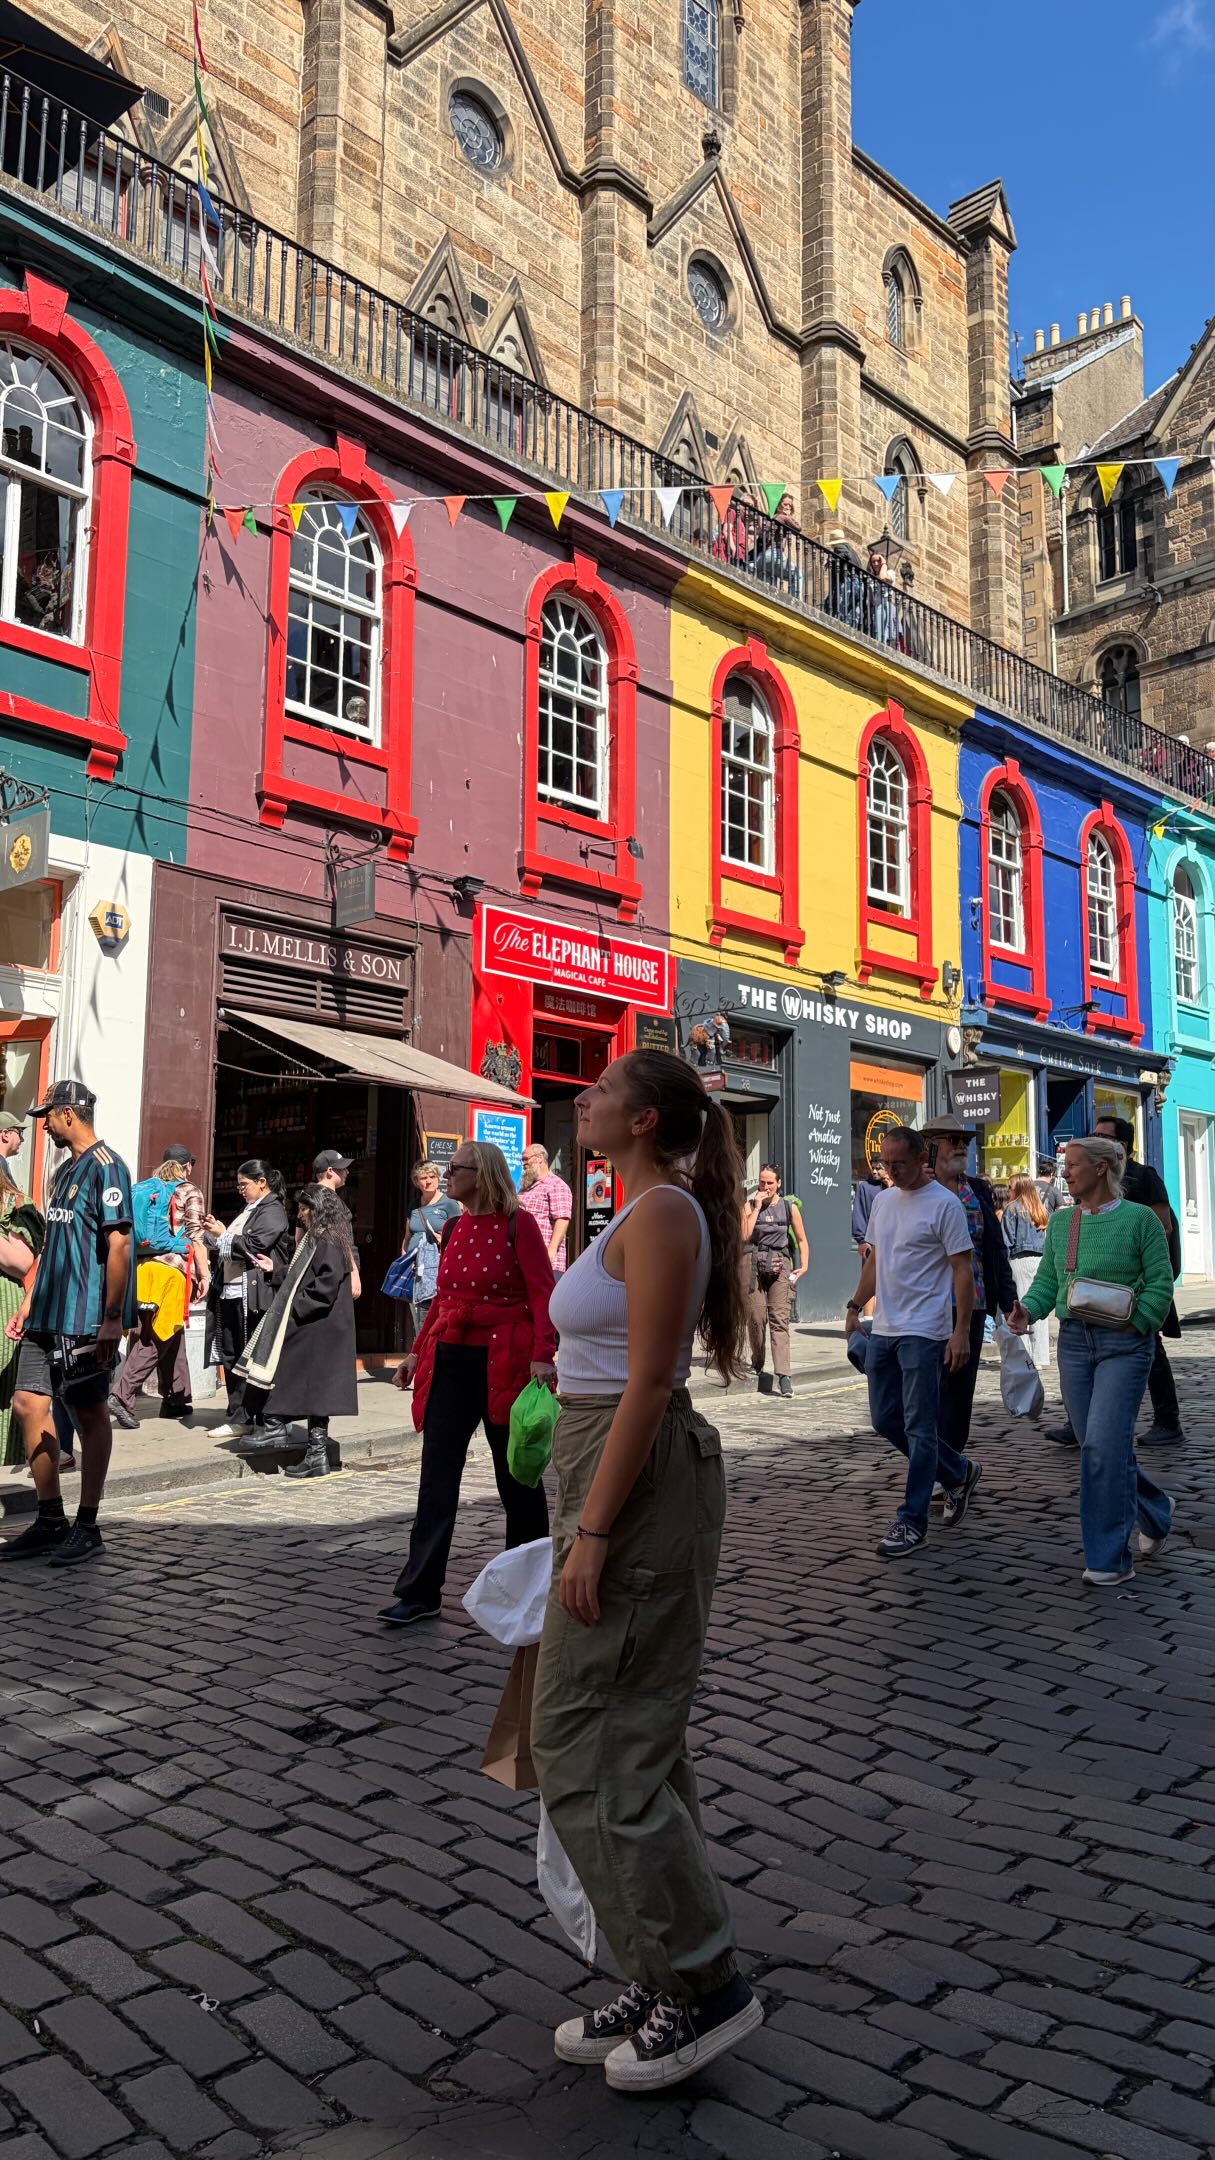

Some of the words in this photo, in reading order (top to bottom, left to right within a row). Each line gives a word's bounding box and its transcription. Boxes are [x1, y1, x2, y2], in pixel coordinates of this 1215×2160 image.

[106, 915, 123, 927] ADT
[493, 922, 535, 952] The
[532, 932, 611, 974] ELEPHANT
[613, 952, 658, 985] HOUSE
[343, 950, 356, 972] &
[361, 954, 401, 981] SON
[554, 967, 587, 983] MAGICAL
[588, 975, 606, 988] CAFE
[737, 984, 778, 1012] THE
[783, 993, 860, 1030] WHISKY
[865, 1013, 912, 1041] SHOP
[966, 1078, 986, 1088] THE
[956, 1091, 998, 1105] WHISKY
[808, 1103, 823, 1121] Not
[822, 1109, 841, 1129] Just
[962, 1107, 991, 1118] SHOP
[430, 1140, 453, 1150] CHEESE
[808, 1127, 842, 1145] Another
[808, 1147, 841, 1174] Whisky
[106, 1192, 120, 1203] JD
